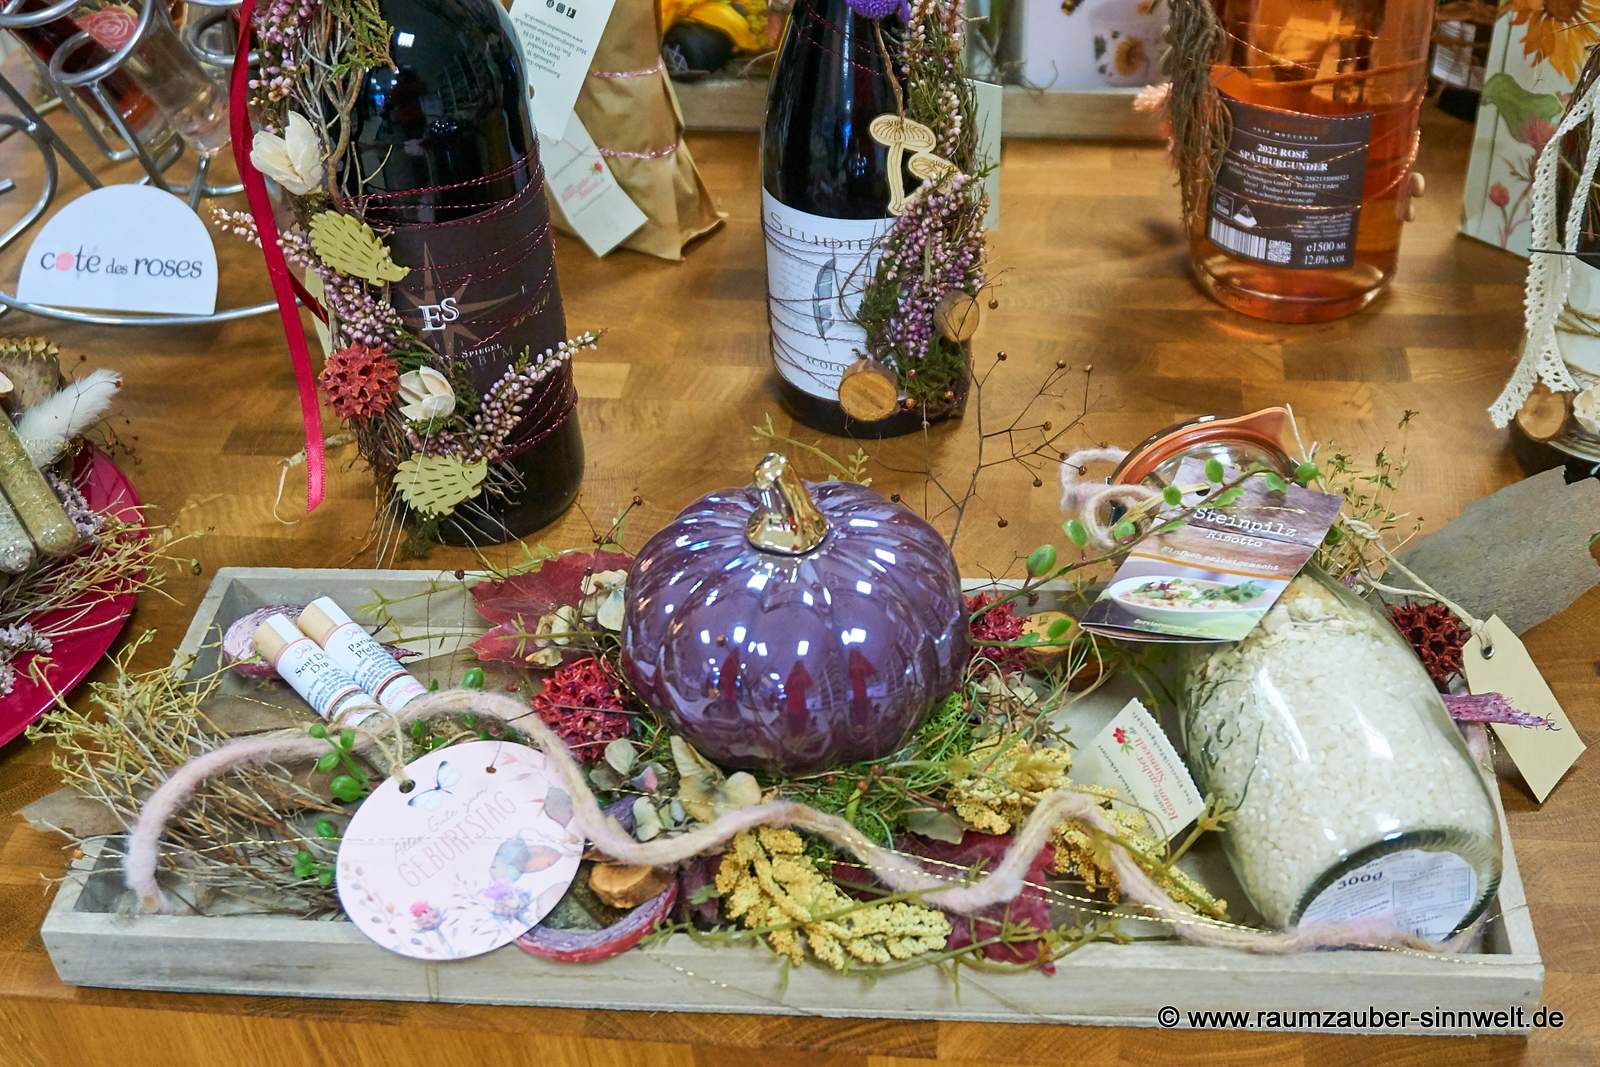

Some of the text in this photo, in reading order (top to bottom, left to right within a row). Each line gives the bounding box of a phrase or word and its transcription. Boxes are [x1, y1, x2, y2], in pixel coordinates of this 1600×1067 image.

[1239, 148, 1329, 172] SPÄTBURGUNDER
[1257, 143, 1309, 160] 2022 ROSÉ
[106, 258, 128, 275] des
[134, 256, 203, 279] roses
[1304, 255, 1329, 265] 12.0%
[418, 298, 461, 331] ES
[461, 343, 503, 359] SPIEGEL
[1193, 507, 1297, 538] Steinpilz
[1206, 530, 1264, 549] Risotto
[295, 655, 316, 677] Senf
[310, 660, 330, 675] Dip
[398, 790, 517, 888] GEBURTSTAG
